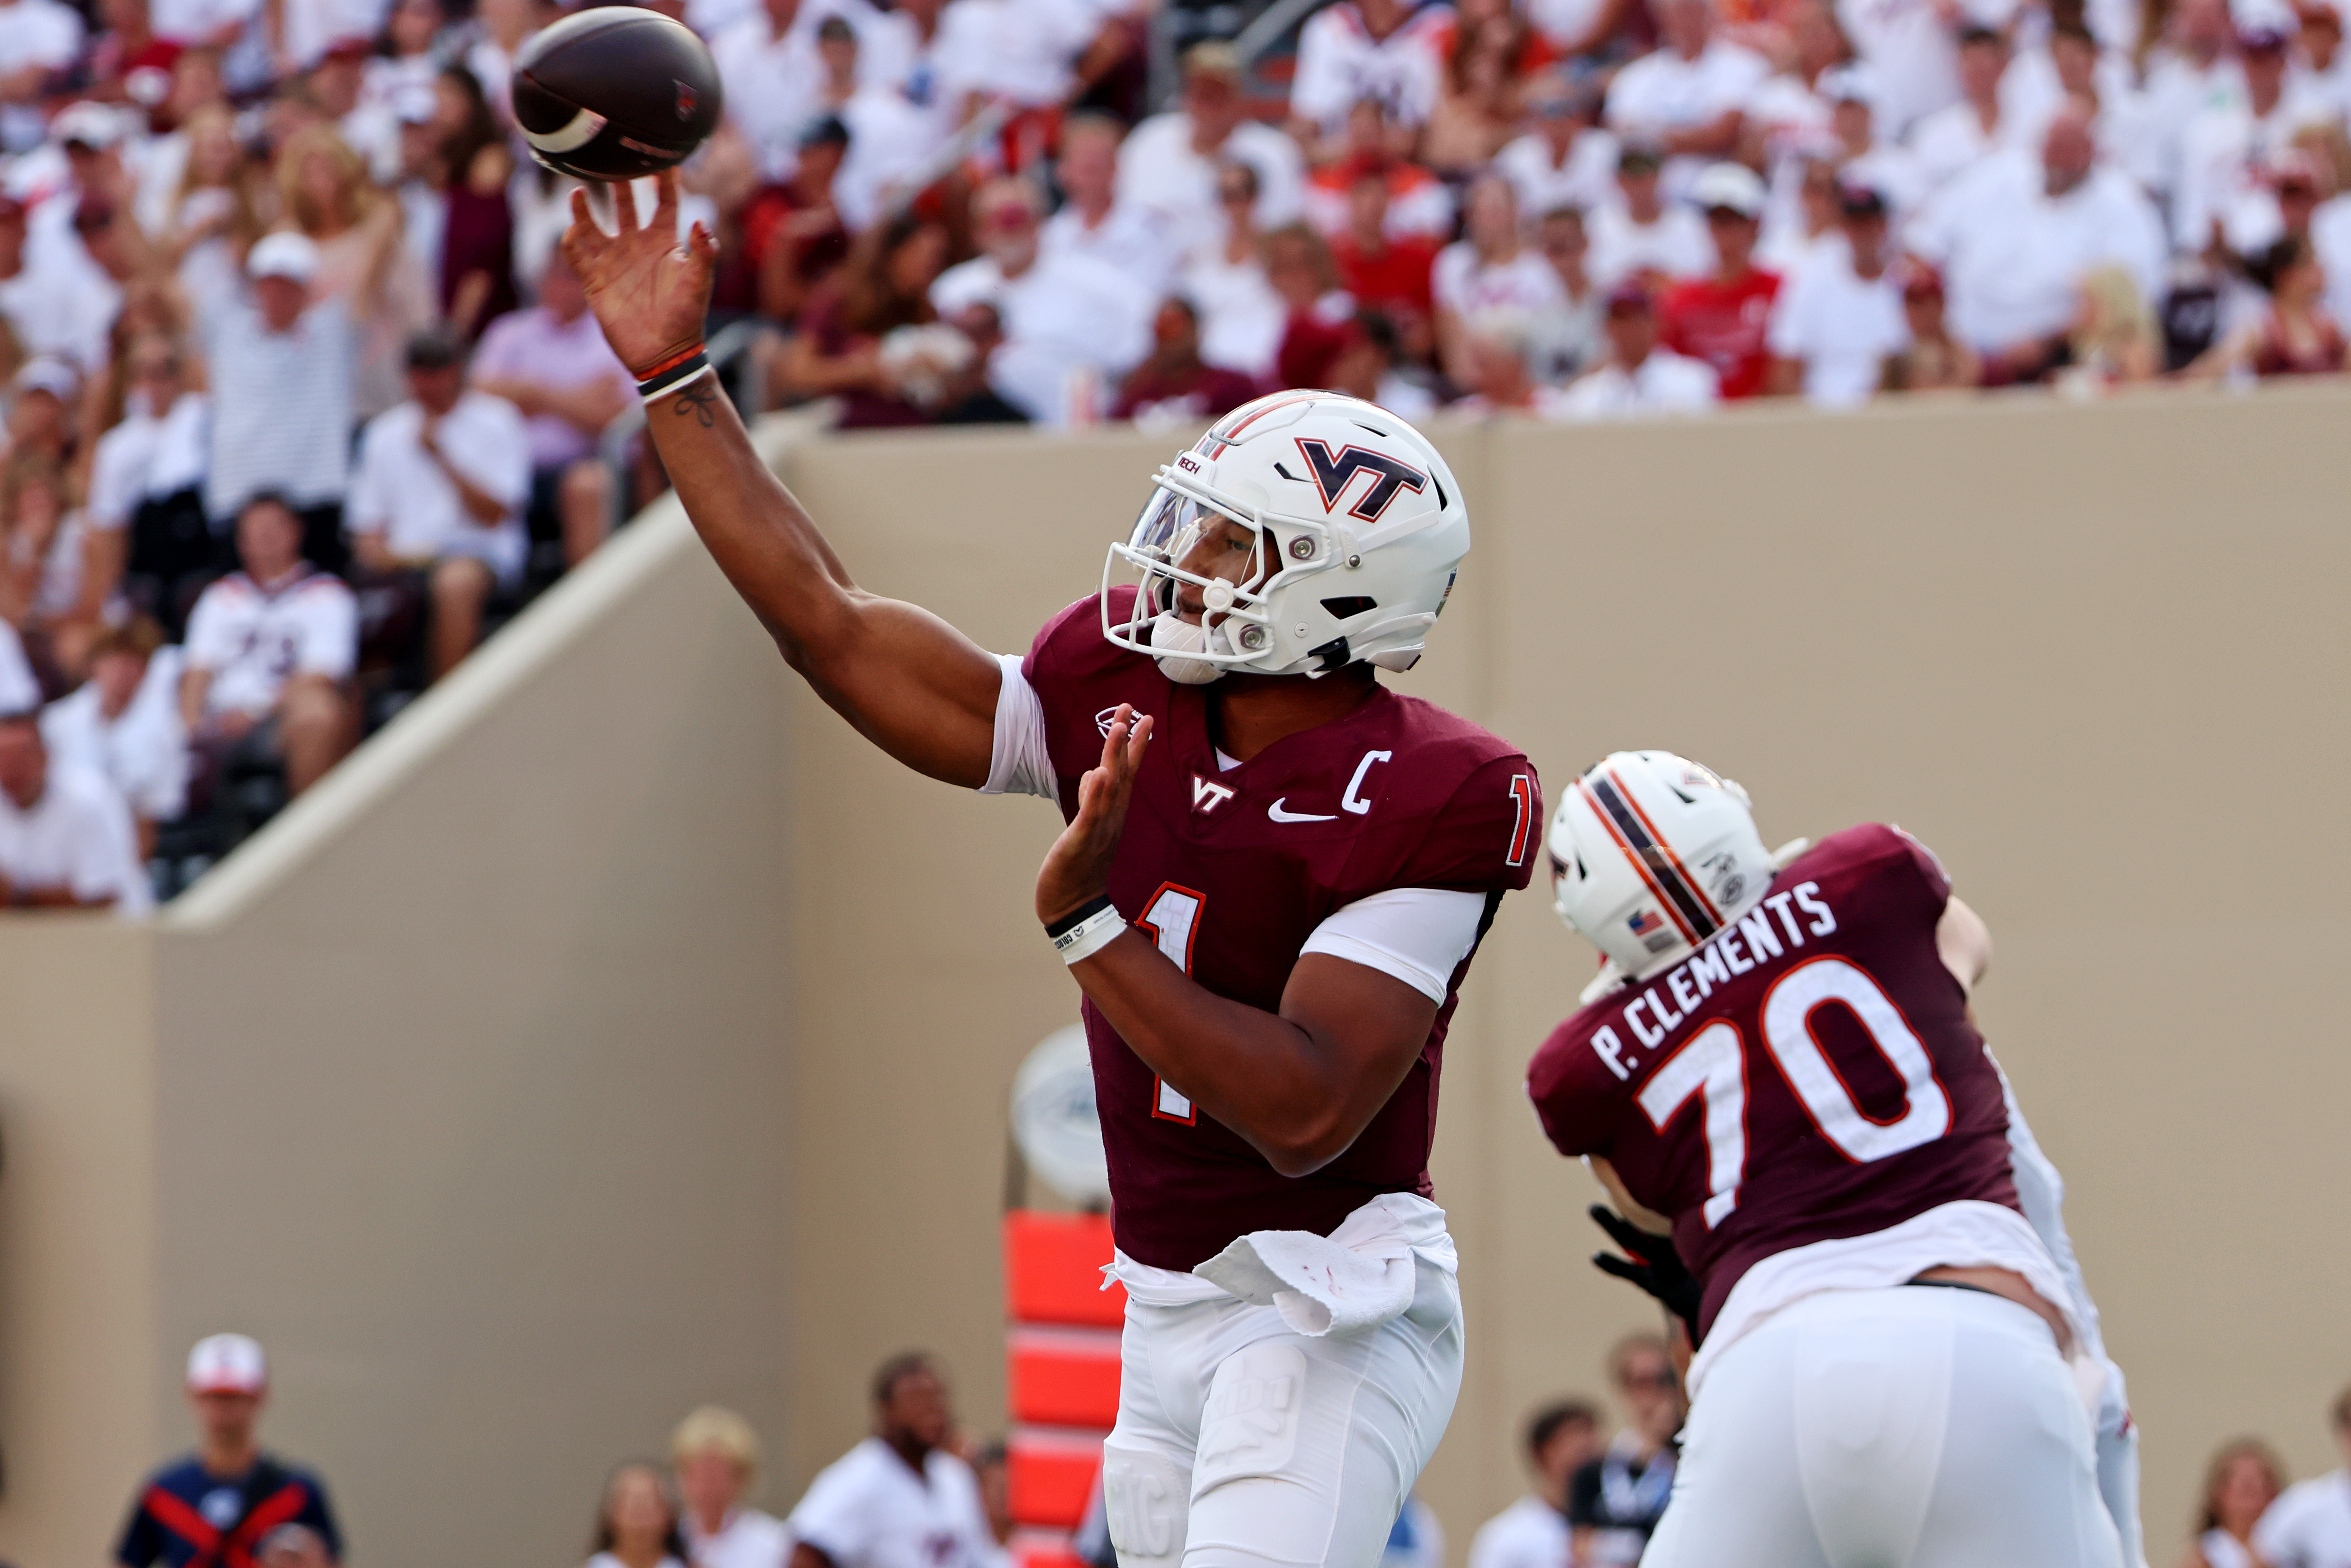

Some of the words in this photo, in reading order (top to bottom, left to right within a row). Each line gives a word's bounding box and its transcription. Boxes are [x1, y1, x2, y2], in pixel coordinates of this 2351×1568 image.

[1177, 456, 1201, 474] TECH
[1294, 437, 1429, 523] VT
[1191, 770, 1239, 816] VT
[1341, 749, 1392, 815] C
[1505, 774, 1532, 867] 1
[1589, 1024, 1639, 1082] P.
[1622, 880, 1837, 1051] CLEMENTS
[1632, 954, 1954, 1233] 70
